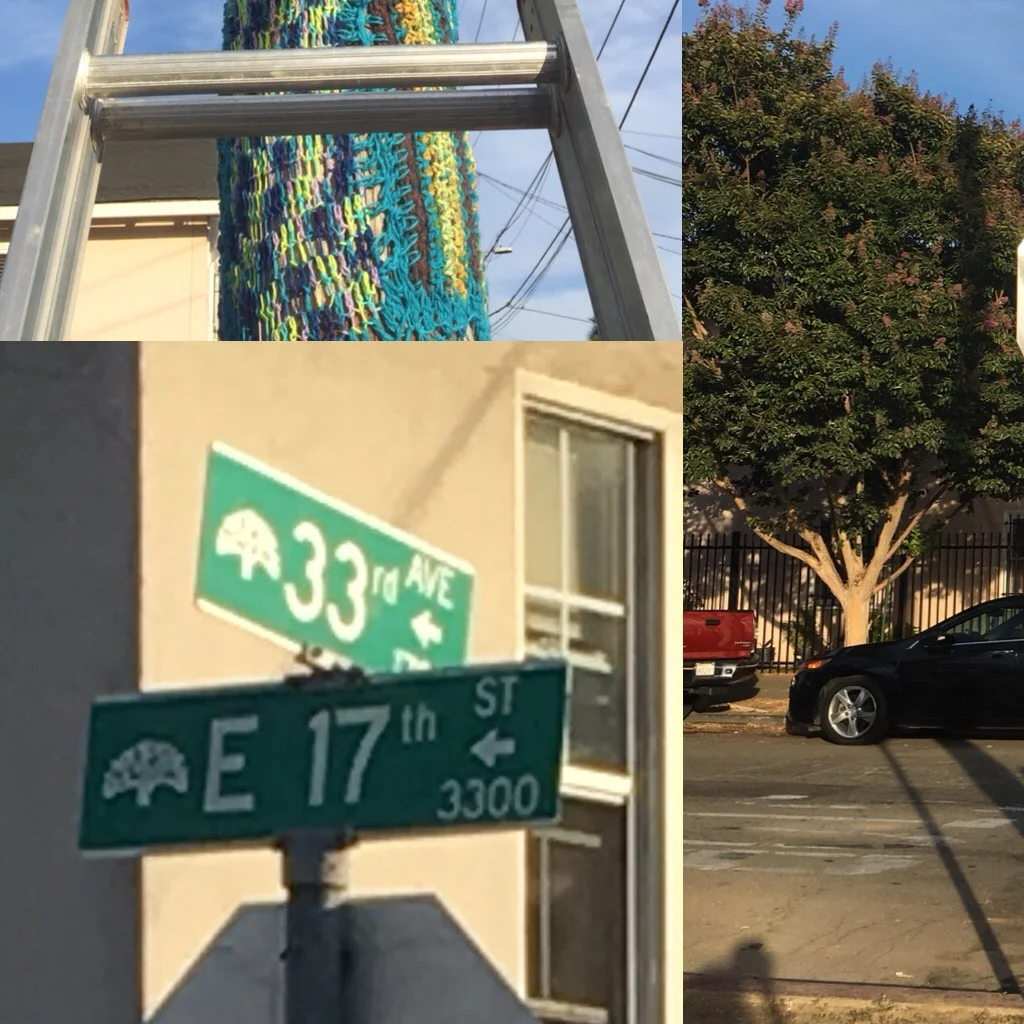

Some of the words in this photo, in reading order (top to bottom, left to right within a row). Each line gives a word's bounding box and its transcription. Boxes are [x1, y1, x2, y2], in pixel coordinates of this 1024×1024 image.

[404, 553, 455, 611] AVE
[203, 714, 260, 813] E
[472, 675, 519, 718] ST
[435, 773, 541, 821] 3300
